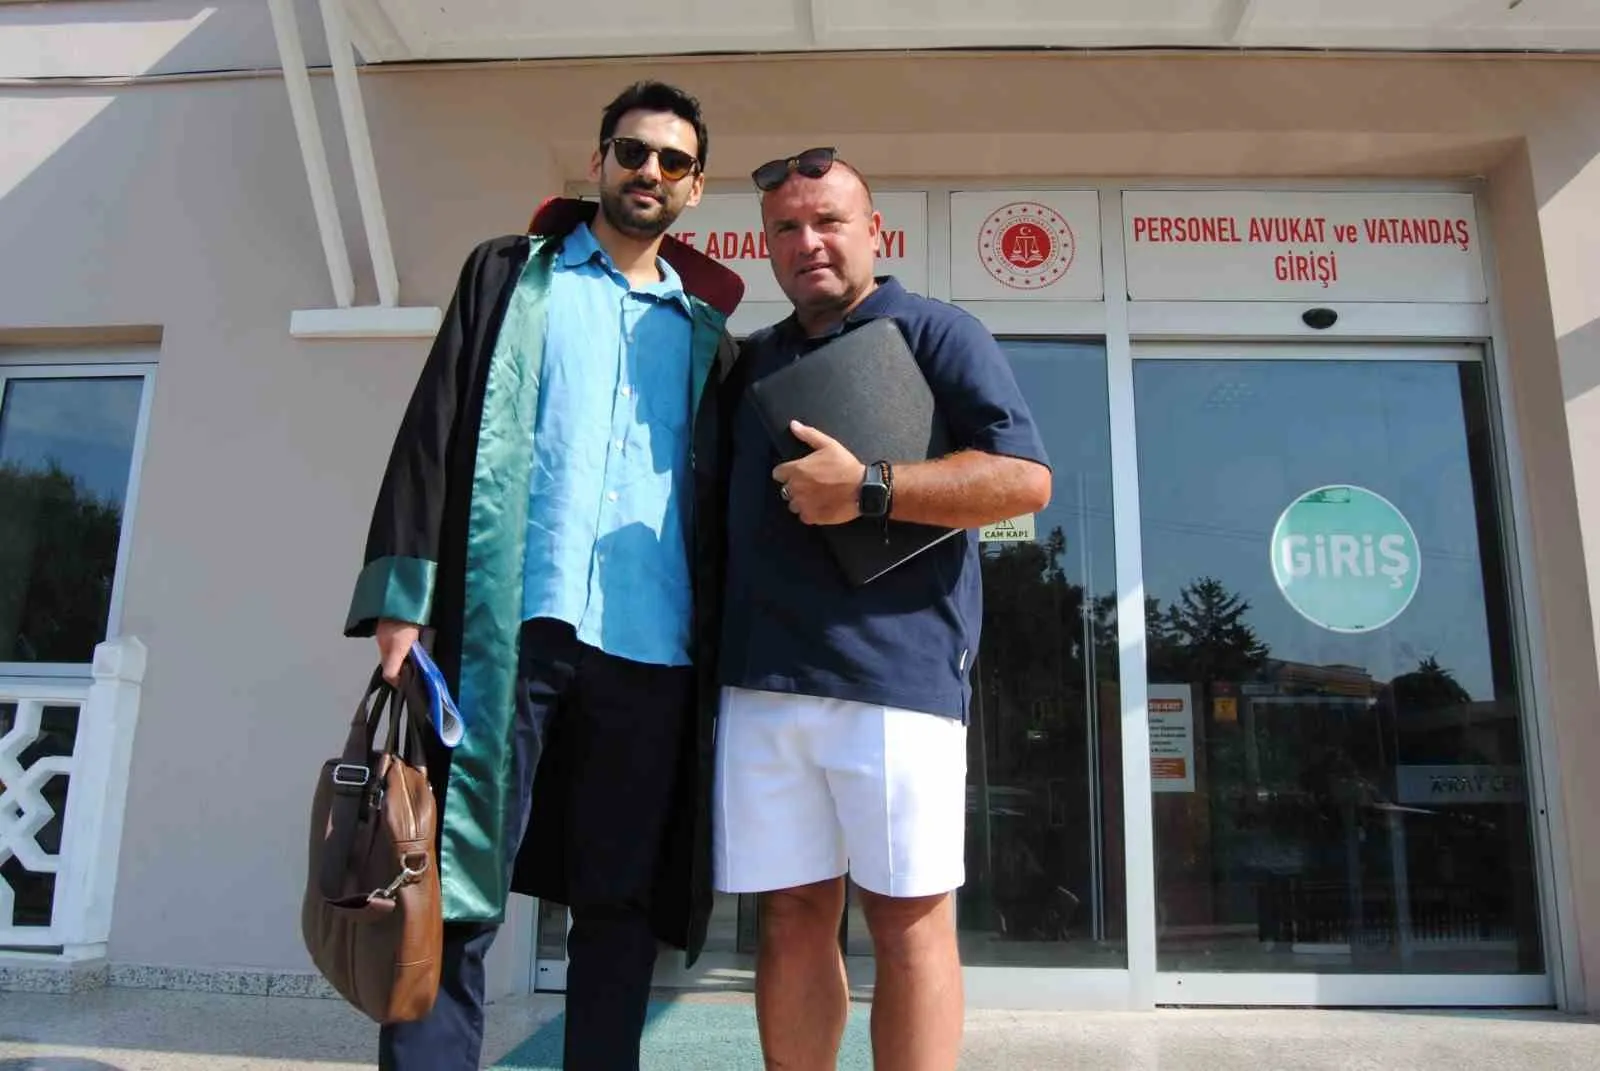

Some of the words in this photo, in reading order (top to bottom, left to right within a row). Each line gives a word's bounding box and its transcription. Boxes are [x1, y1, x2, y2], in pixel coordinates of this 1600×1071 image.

[704, 231, 773, 259] ADAL
[1134, 217, 1241, 243] PERSONEL
[1249, 218, 1326, 244] AVUKAT
[1334, 225, 1358, 245] ve
[1363, 218, 1469, 252] VATANDAŞ
[1275, 251, 1338, 289] GİRİŞİ
